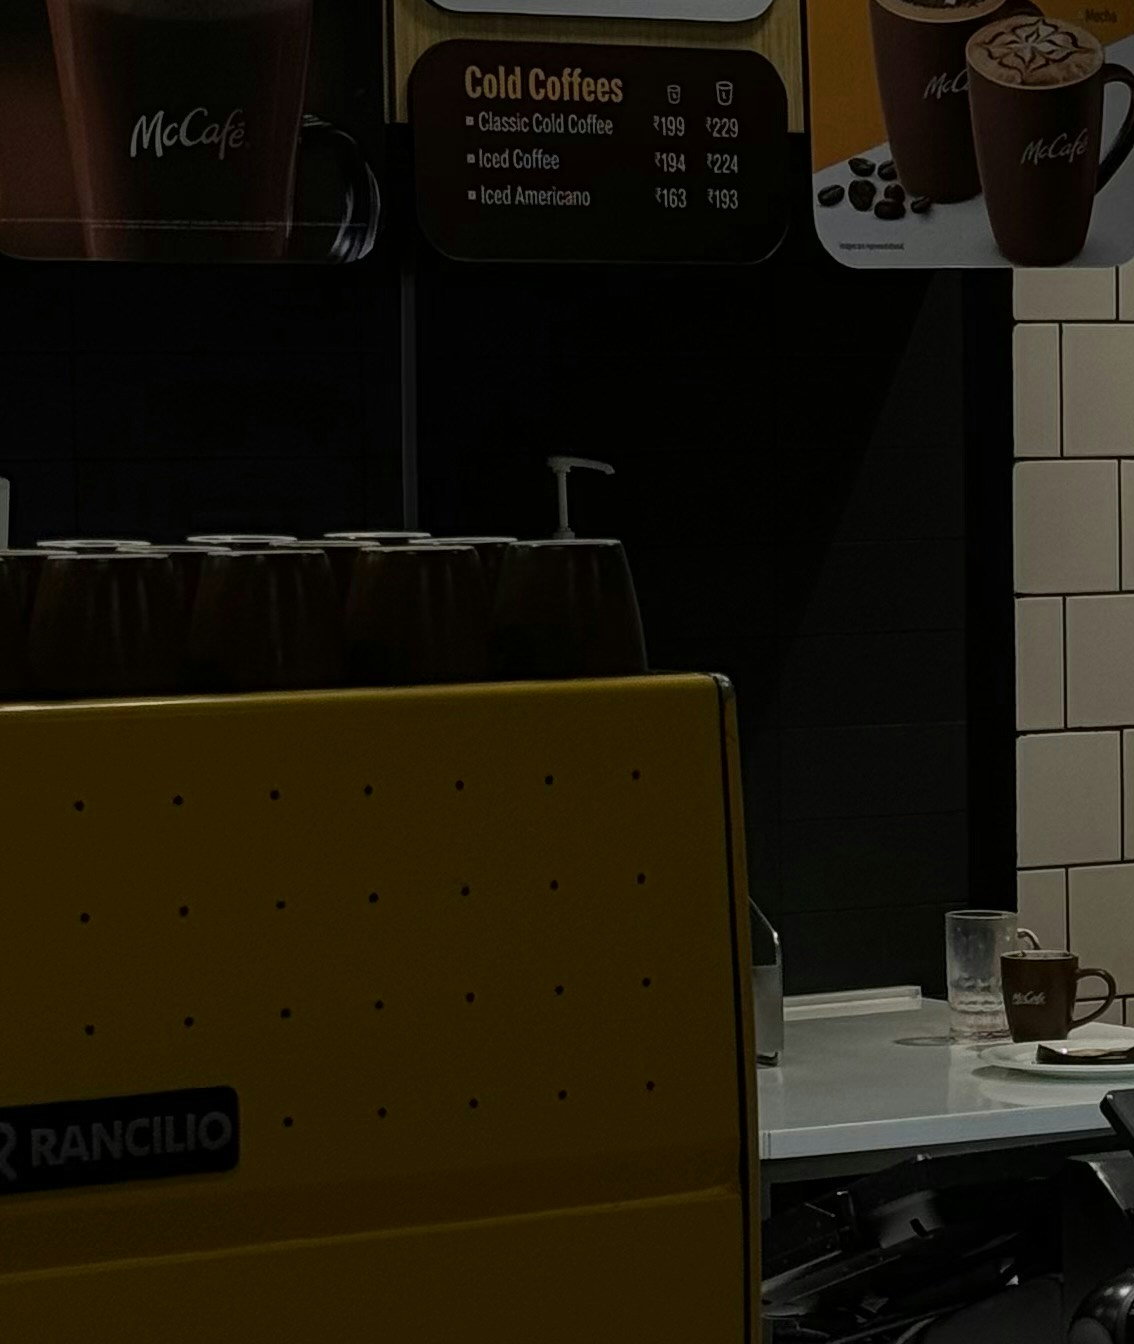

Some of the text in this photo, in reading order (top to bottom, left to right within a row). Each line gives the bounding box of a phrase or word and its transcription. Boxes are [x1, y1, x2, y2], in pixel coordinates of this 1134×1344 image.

[464, 65, 624, 103] Cold Coffees
[922, 67, 969, 100] McC
[478, 111, 613, 136] Classic Cold Coffee
[653, 115, 685, 136] ₹199
[706, 116, 738, 138] ₹229
[478, 149, 560, 171] Iced Coffee
[654, 152, 686, 173] ₹194
[707, 152, 738, 174] ₹224
[480, 185, 591, 207] Iced Americano
[655, 187, 687, 208] ₹163
[707, 188, 738, 210] ₹193
[30, 1111, 232, 1169] RANCILIO
